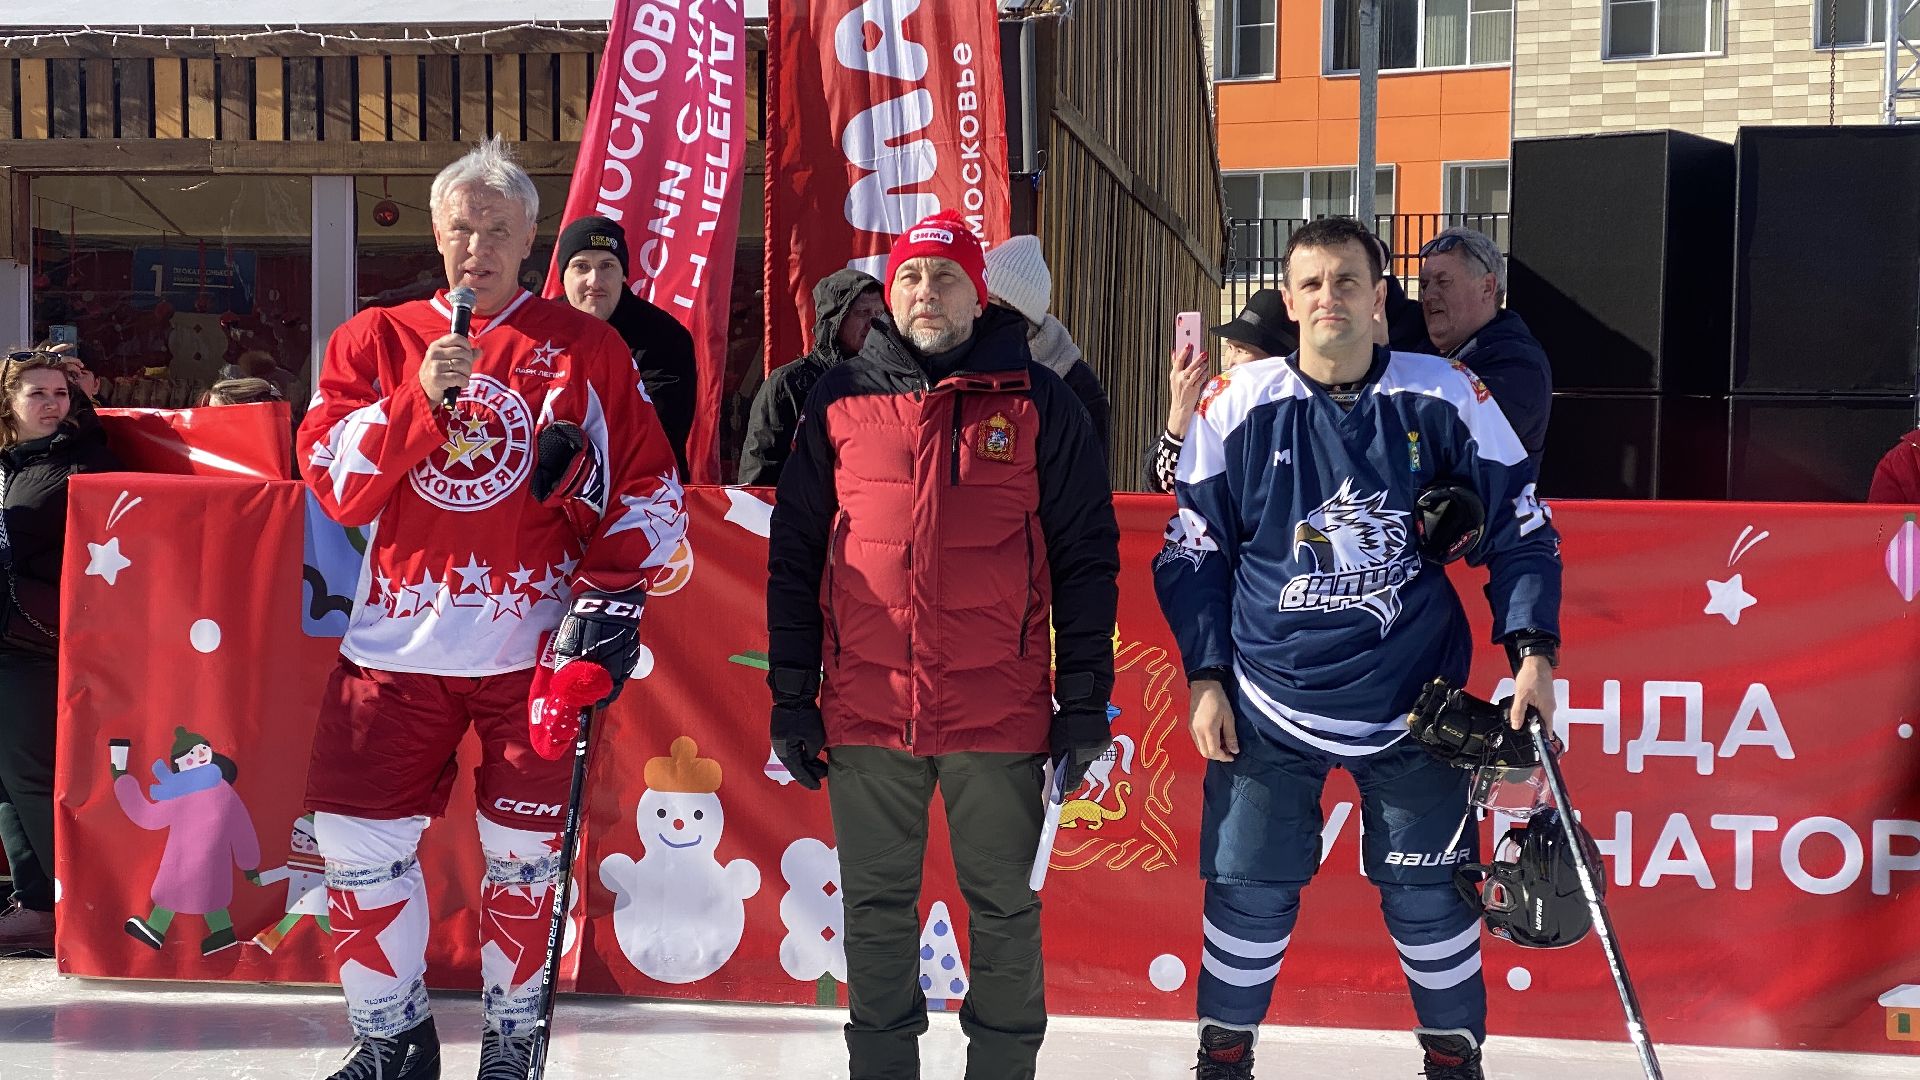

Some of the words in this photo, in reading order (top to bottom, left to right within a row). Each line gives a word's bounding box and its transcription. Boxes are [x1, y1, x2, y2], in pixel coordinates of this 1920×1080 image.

[835, 0, 940, 286] МА
[913, 231, 950, 241] ЗИМА
[419, 470, 512, 501] ХОККЕЯ
[494, 797, 562, 817] CCM
[548, 918, 559, 947] PRO
